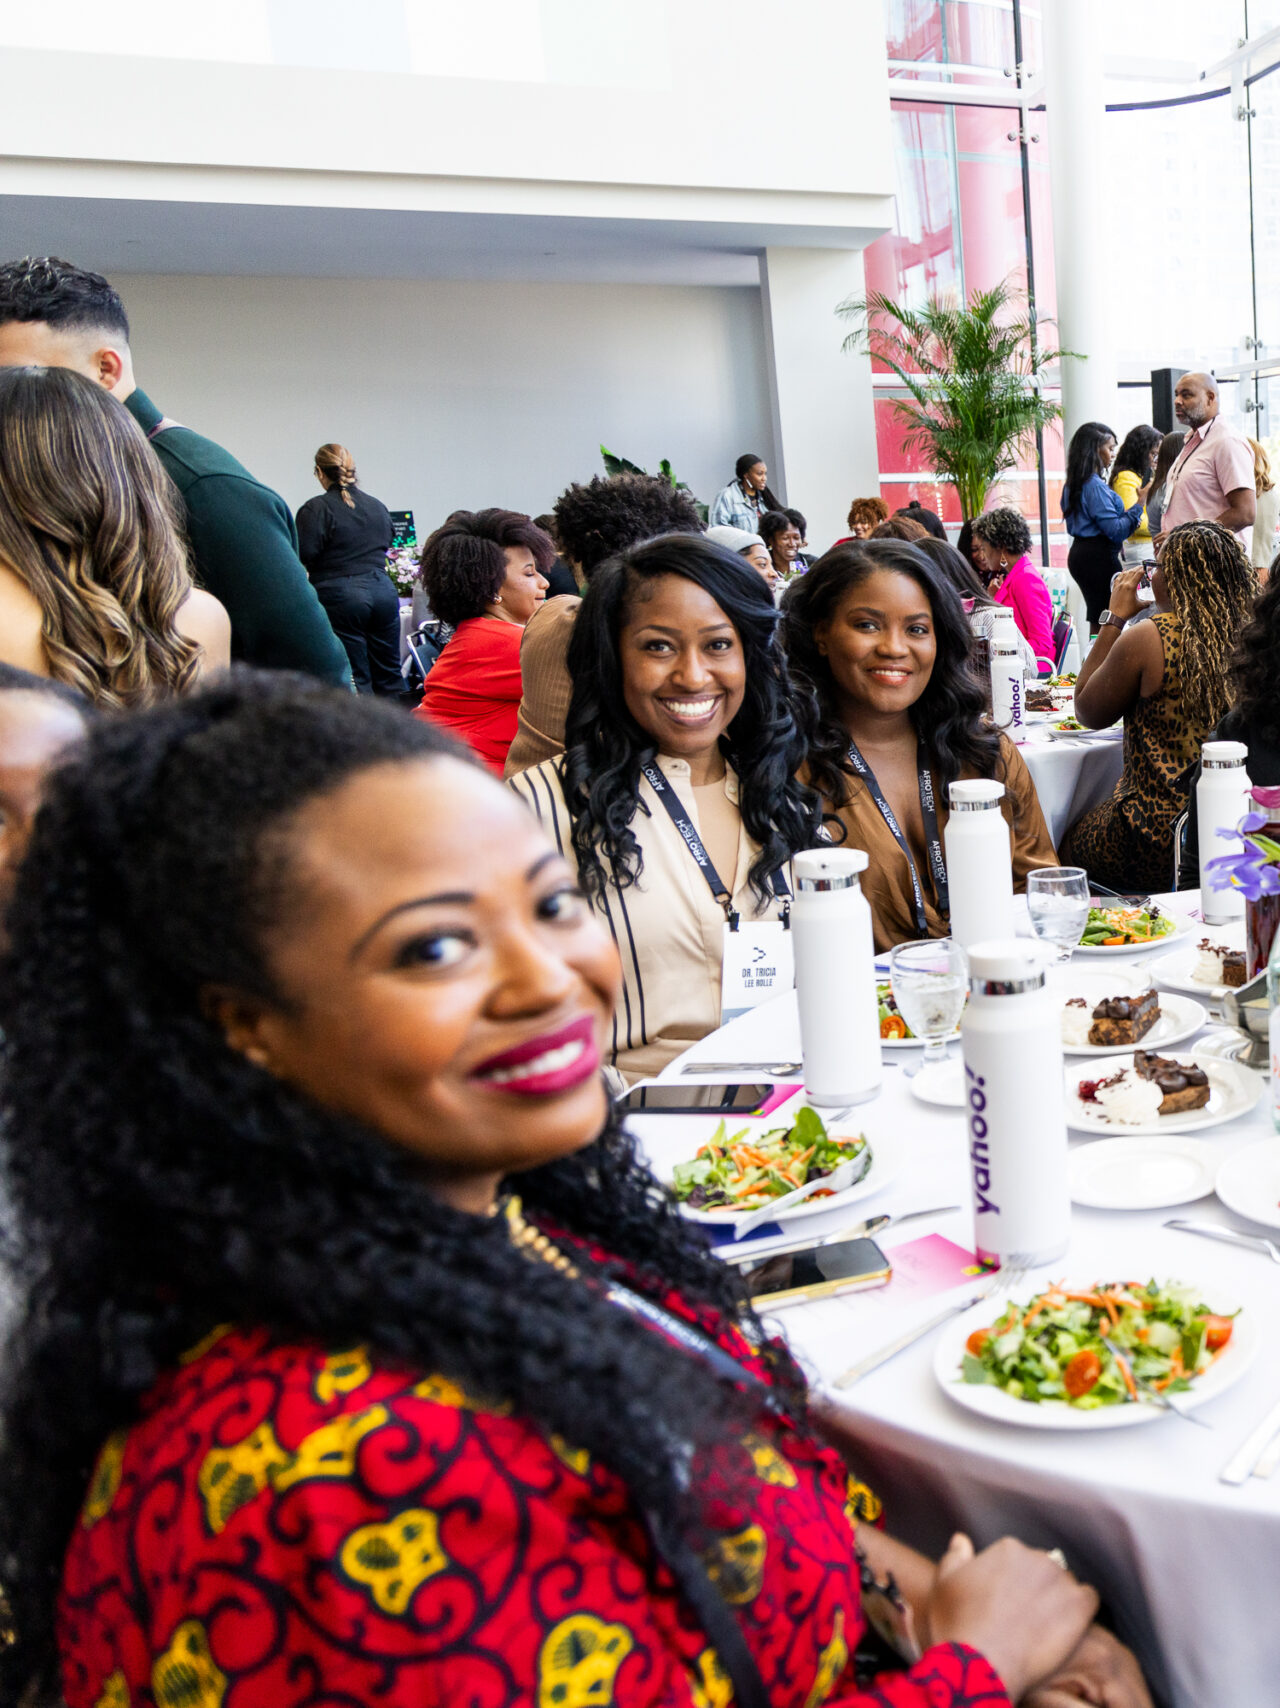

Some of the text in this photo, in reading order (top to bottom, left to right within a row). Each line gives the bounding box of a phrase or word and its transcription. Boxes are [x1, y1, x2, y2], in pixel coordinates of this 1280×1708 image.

[1008, 677, 1023, 728] yahoo!
[922, 769, 935, 812] AFROTECH
[875, 798, 901, 838] AFROTECH
[676, 819, 708, 867] AFROTECH
[932, 840, 948, 885] AFROTECH
[744, 979, 755, 989] LEE
[755, 967, 776, 978] TRICIA
[964, 1061, 1001, 1215] yahoo!
